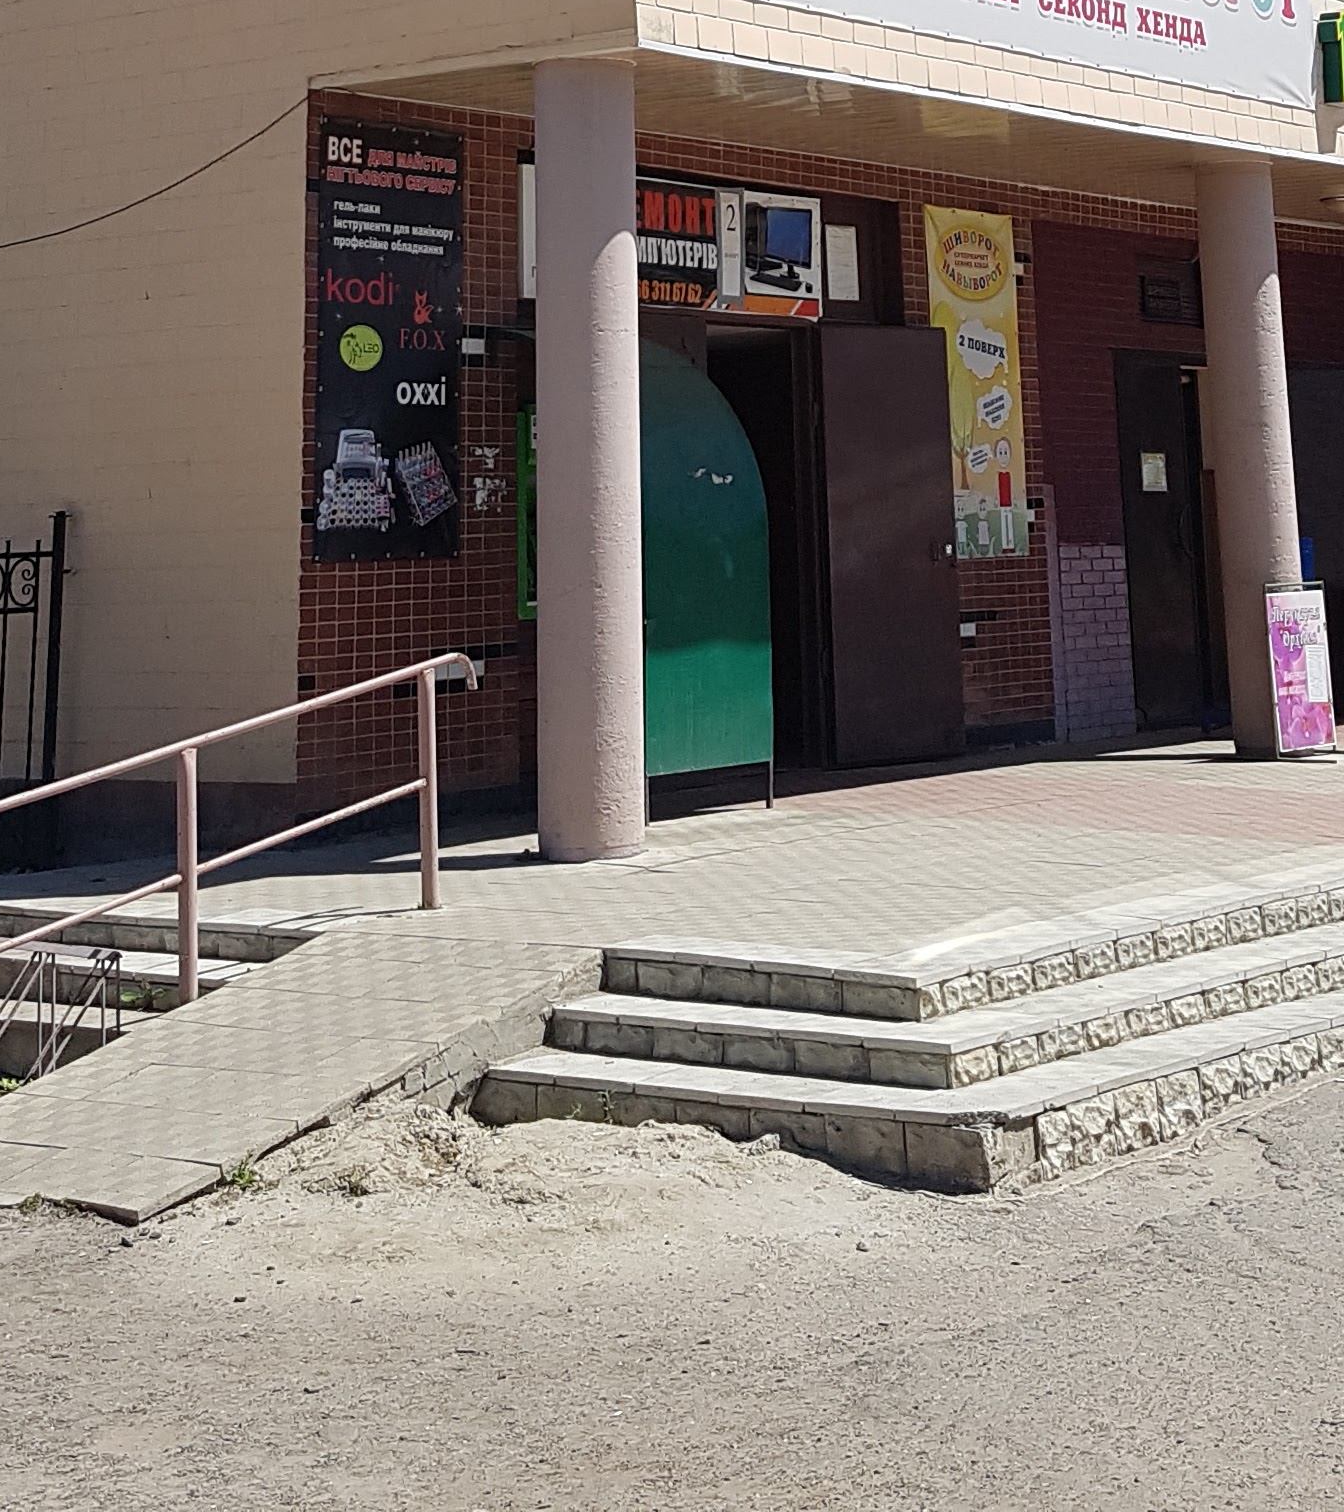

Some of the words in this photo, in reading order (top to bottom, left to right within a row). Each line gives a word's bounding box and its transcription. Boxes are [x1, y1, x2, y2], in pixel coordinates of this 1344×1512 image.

[1136, 3, 1208, 48] ХЕНДА
[327, 135, 363, 164] ВСЕ
[367, 148, 394, 167] ДЛЯ
[396, 150, 457, 174] МАЙСТРІВ
[326, 165, 404, 189] НІГТЬОВОГО
[405, 174, 457, 195] СЕРВІСУ
[725, 203, 737, 232] 2
[942, 229, 1000, 257] ШИВОРОТ
[325, 268, 394, 306] kodi
[941, 259, 1003, 291] НАВЫВОРОТ
[651, 280, 671, 302] 311
[672, 281, 686, 303] 67
[687, 283, 703, 304] 62
[363, 343, 380, 354] LEO
[958, 334, 966, 347] 2
[967, 337, 1006, 359] ПОВЕРХ
[396, 376, 446, 406] oxxi
